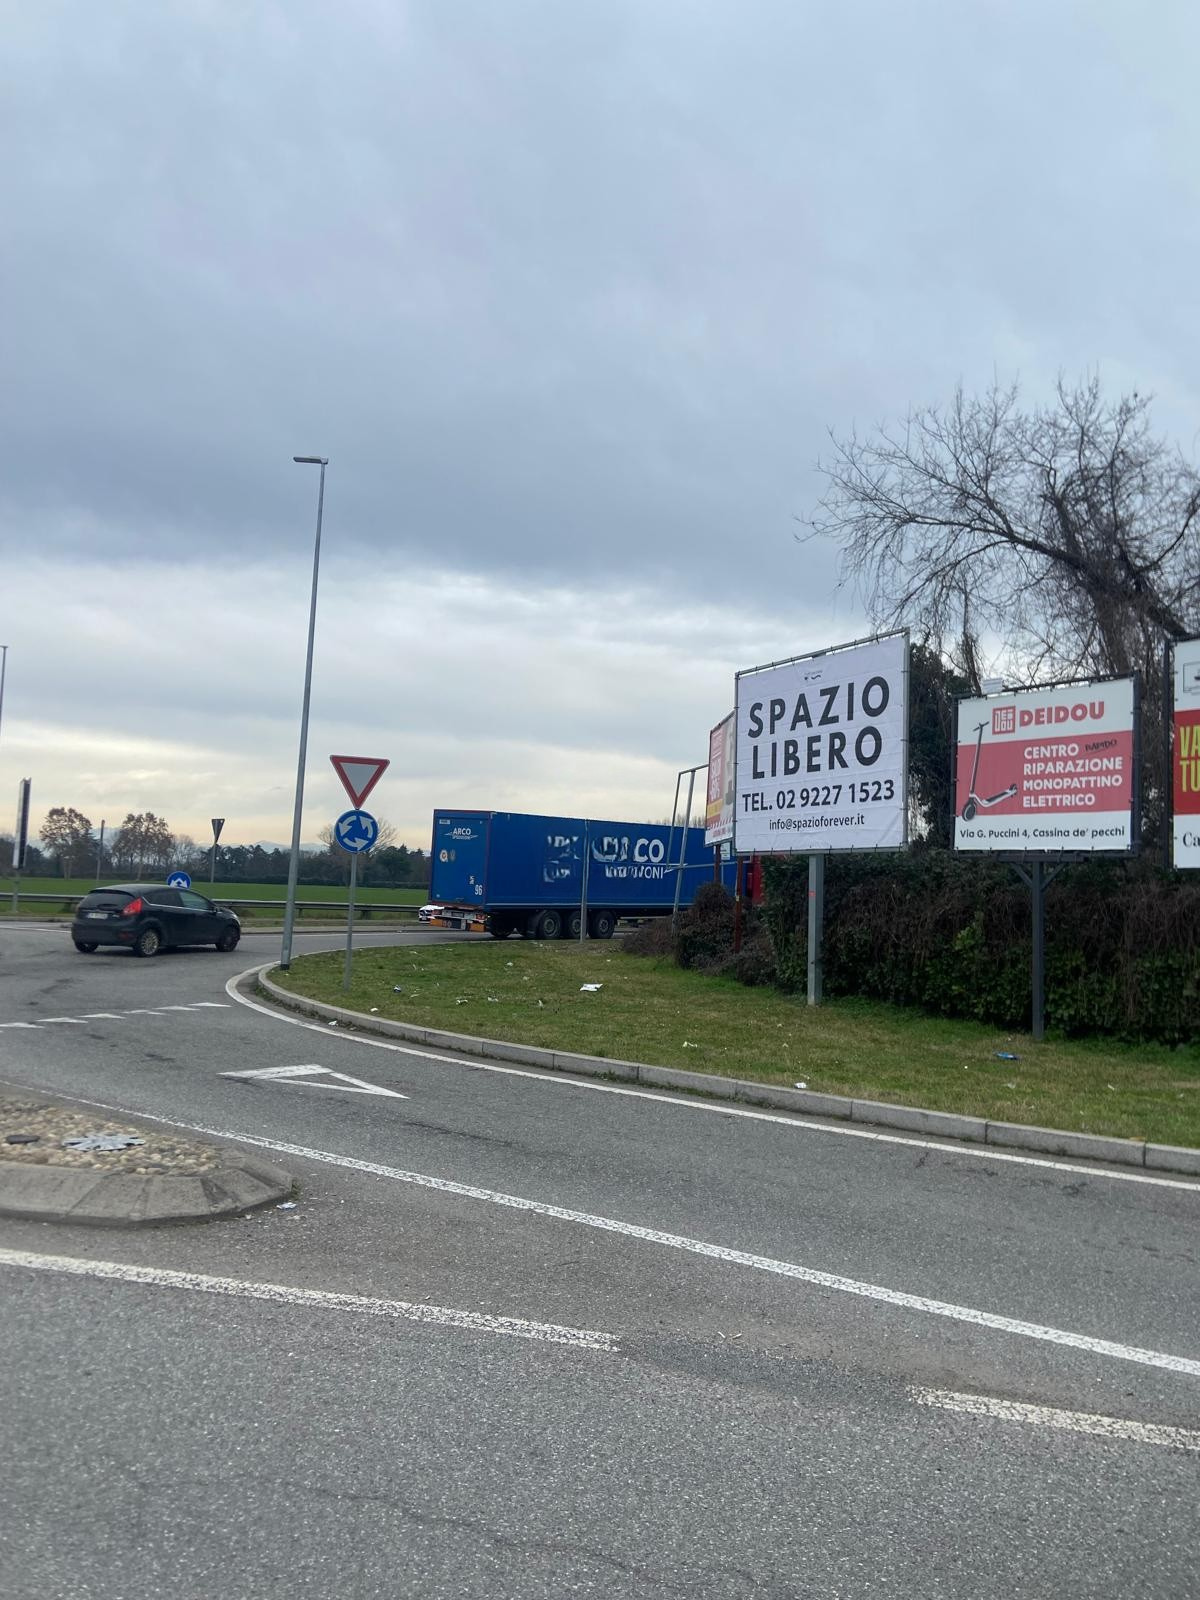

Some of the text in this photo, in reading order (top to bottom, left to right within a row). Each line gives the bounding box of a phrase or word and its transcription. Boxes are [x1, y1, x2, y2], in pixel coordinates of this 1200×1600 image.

[748, 676, 889, 738] SPAZIO
[1019, 701, 1105, 727] DEIDOU
[752, 726, 882, 779] LIBERO
[1024, 743, 1080, 760] CENTRO
[1023, 756, 1123, 775] RIPARAZIONE
[1023, 774, 1123, 791] MONOPATTINO
[742, 792, 773, 812] TEL.
[776, 789, 796, 810] 02
[800, 785, 843, 808] 9227
[849, 779, 895, 803] 1523
[1023, 793, 1096, 808] ELETTRICO
[769, 813, 865, 831] info@spazioforever.it
[452, 827, 472, 836] ARCO
[960, 829, 975, 839] Via
[977, 829, 987, 838] G.
[989, 828, 1020, 838] Puccini
[1022, 829, 1031, 840] 4,
[1033, 827, 1070, 838] Cassina
[1091, 826, 1125, 840] pecchi
[474, 884, 483, 896] 96
